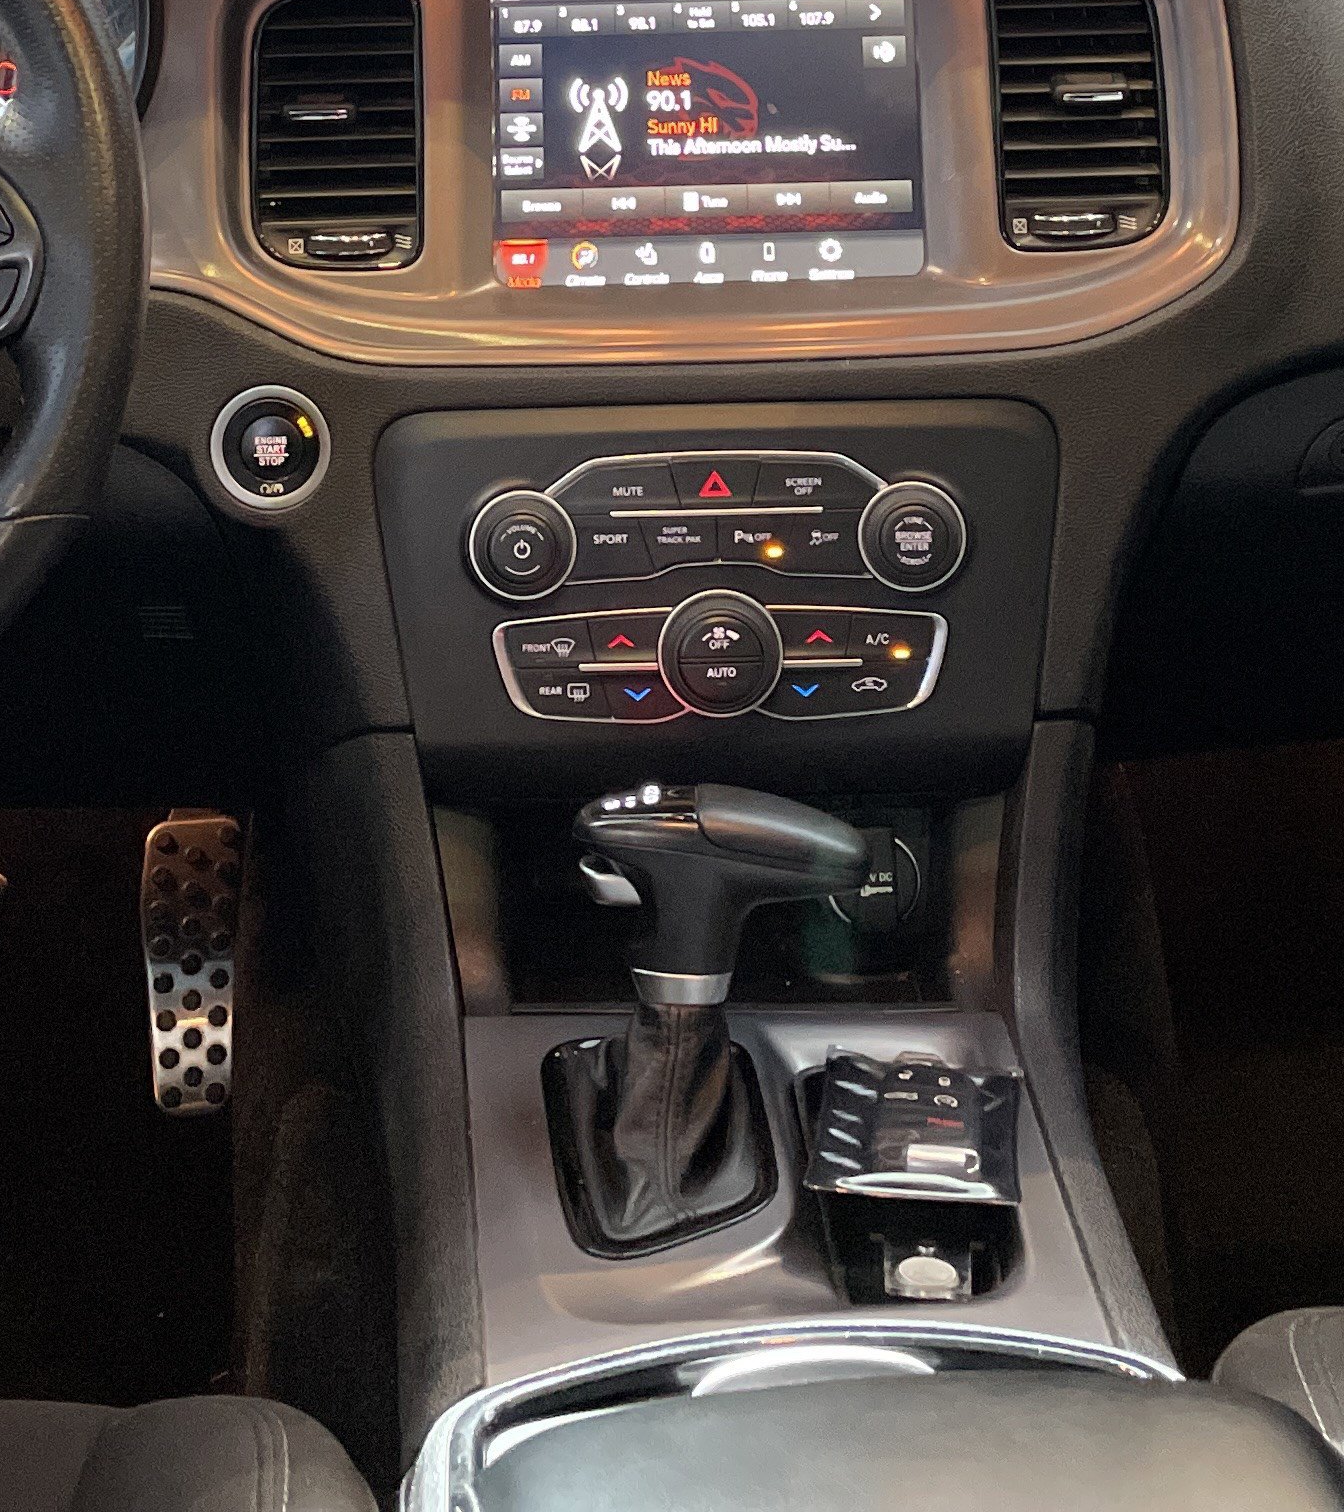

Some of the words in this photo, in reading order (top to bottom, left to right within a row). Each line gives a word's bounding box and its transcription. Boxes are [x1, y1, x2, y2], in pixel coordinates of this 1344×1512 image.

[510, 54, 532, 67] AM
[645, 70, 692, 87] News
[645, 89, 692, 112] 90.1
[646, 118, 697, 137] Sunny
[646, 138, 682, 156] This
[682, 136, 763, 156] Afternoon
[764, 134, 818, 156] Mostly
[256, 445, 286, 454] START
[258, 456, 285, 466] STOP
[785, 477, 822, 487] SCREEN
[612, 486, 643, 497] MUTE
[592, 534, 629, 545] SPORT
[865, 632, 890, 645] A/C
[522, 643, 551, 652] FRONT
[709, 639, 730, 650] OFF
[706, 666, 737, 678] AUTO
[539, 686, 562, 696] REAR
